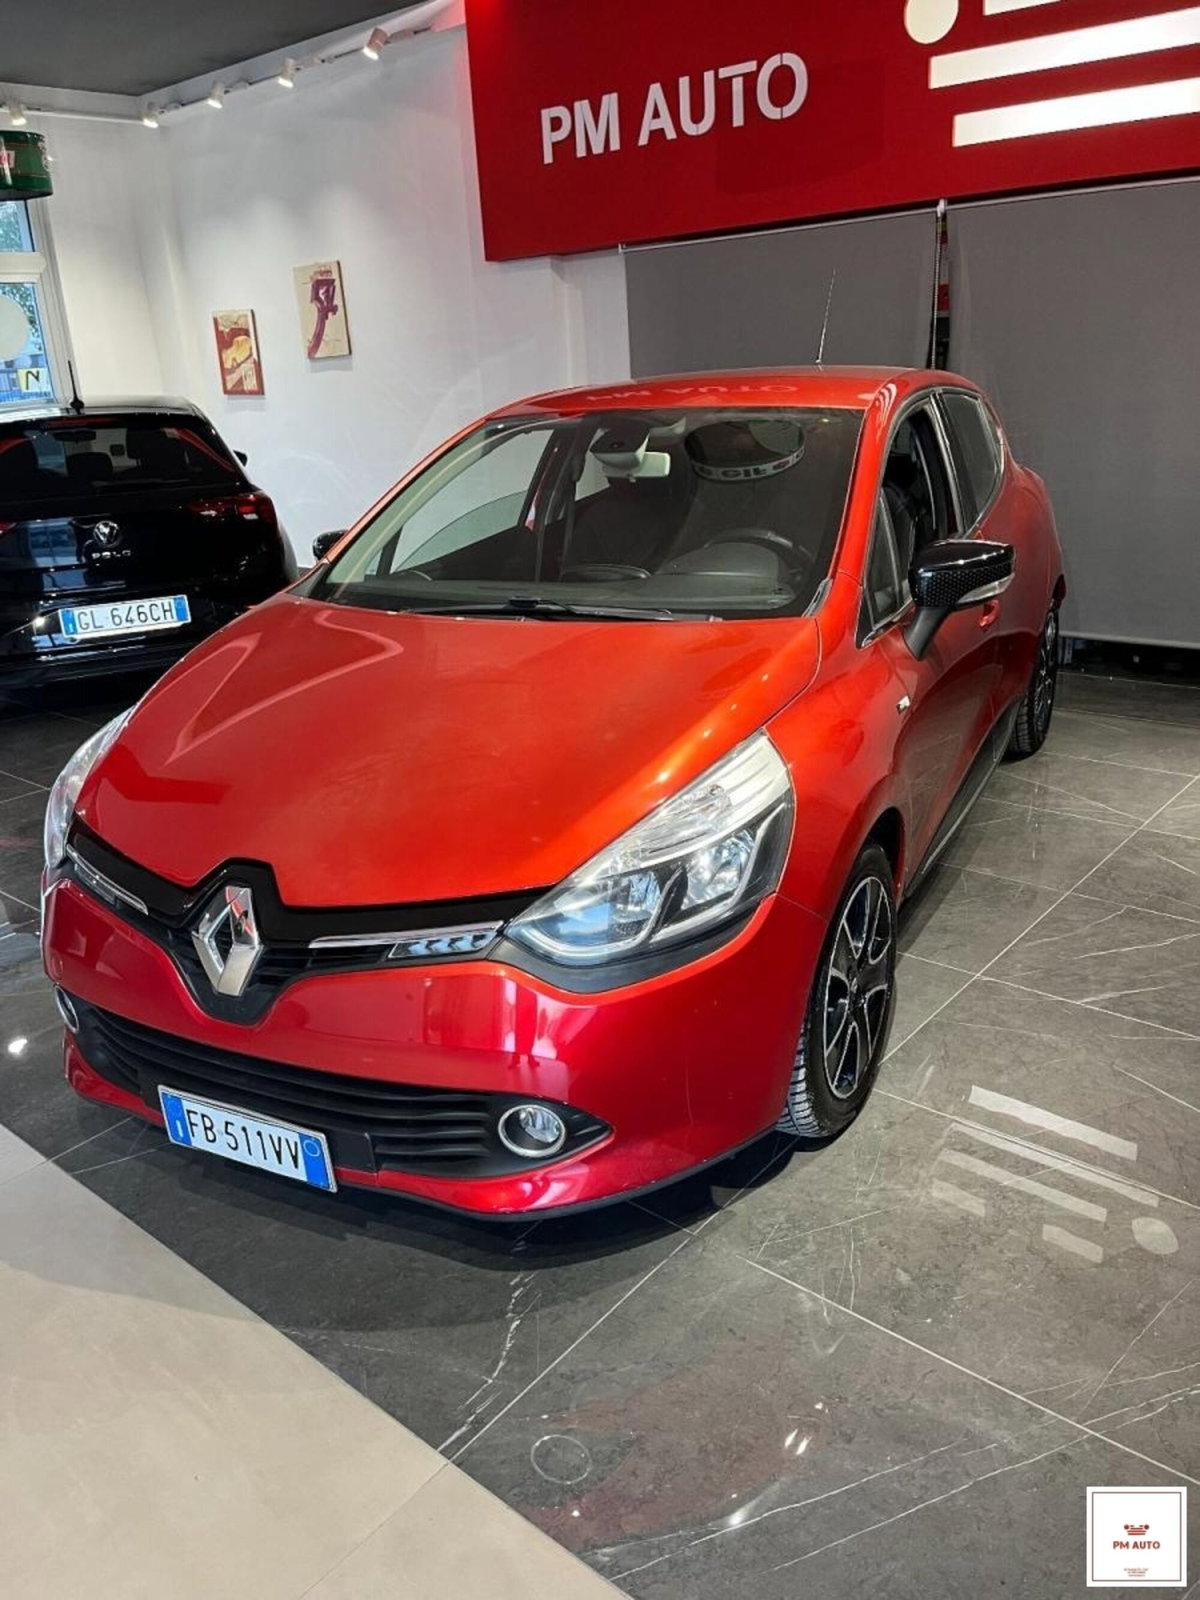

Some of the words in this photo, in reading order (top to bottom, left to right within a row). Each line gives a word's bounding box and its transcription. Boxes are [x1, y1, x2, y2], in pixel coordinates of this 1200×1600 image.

[540, 92, 621, 165] PM
[638, 52, 809, 147] AUTO
[77, 610, 104, 631] GL
[110, 601, 175, 627] 646CH
[186, 1108, 217, 1143] FB
[224, 1120, 299, 1170] 511VV
